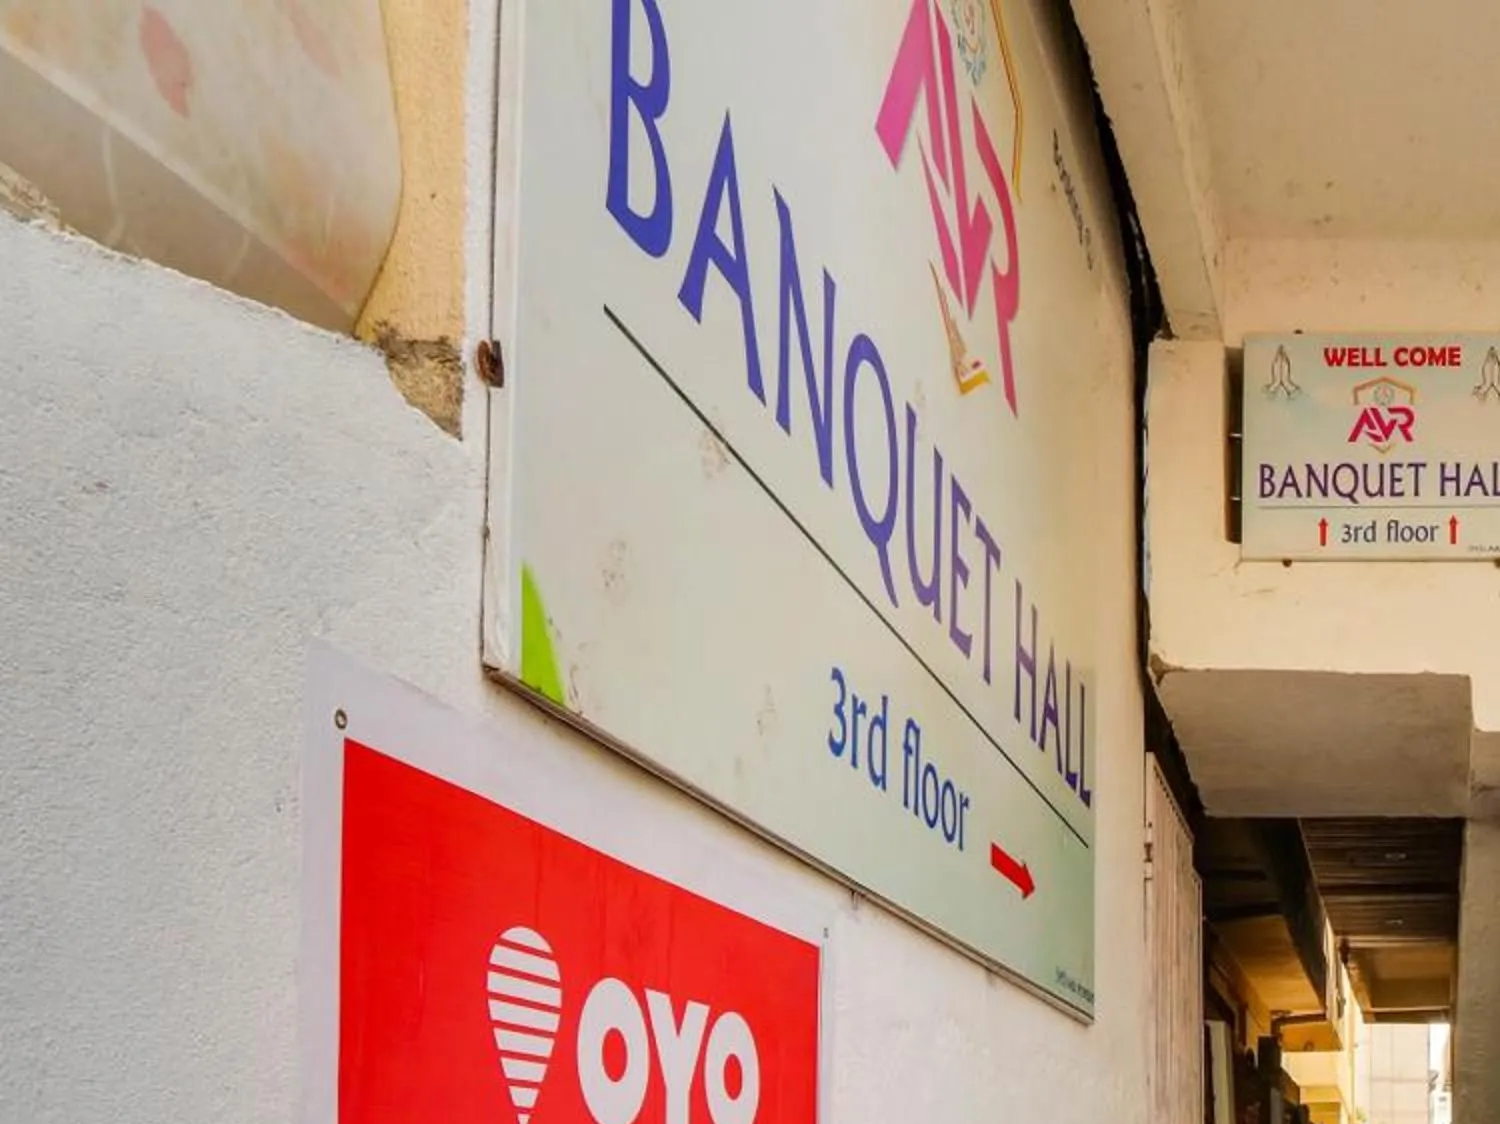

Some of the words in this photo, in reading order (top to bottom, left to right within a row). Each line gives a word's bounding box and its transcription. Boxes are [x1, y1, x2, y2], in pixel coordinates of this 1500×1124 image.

[1323, 347, 1387, 368] WELL
[1393, 346, 1462, 368] COME
[605, 0, 1001, 686] BANQUET
[1014, 577, 1092, 808] HALL
[1348, 407, 1416, 443] AVR
[1258, 463, 1427, 505] BANQUET
[1340, 521, 1378, 544] 3rd
[1386, 520, 1440, 544] floor
[827, 666, 887, 793] 3rd
[903, 717, 970, 851] floor
